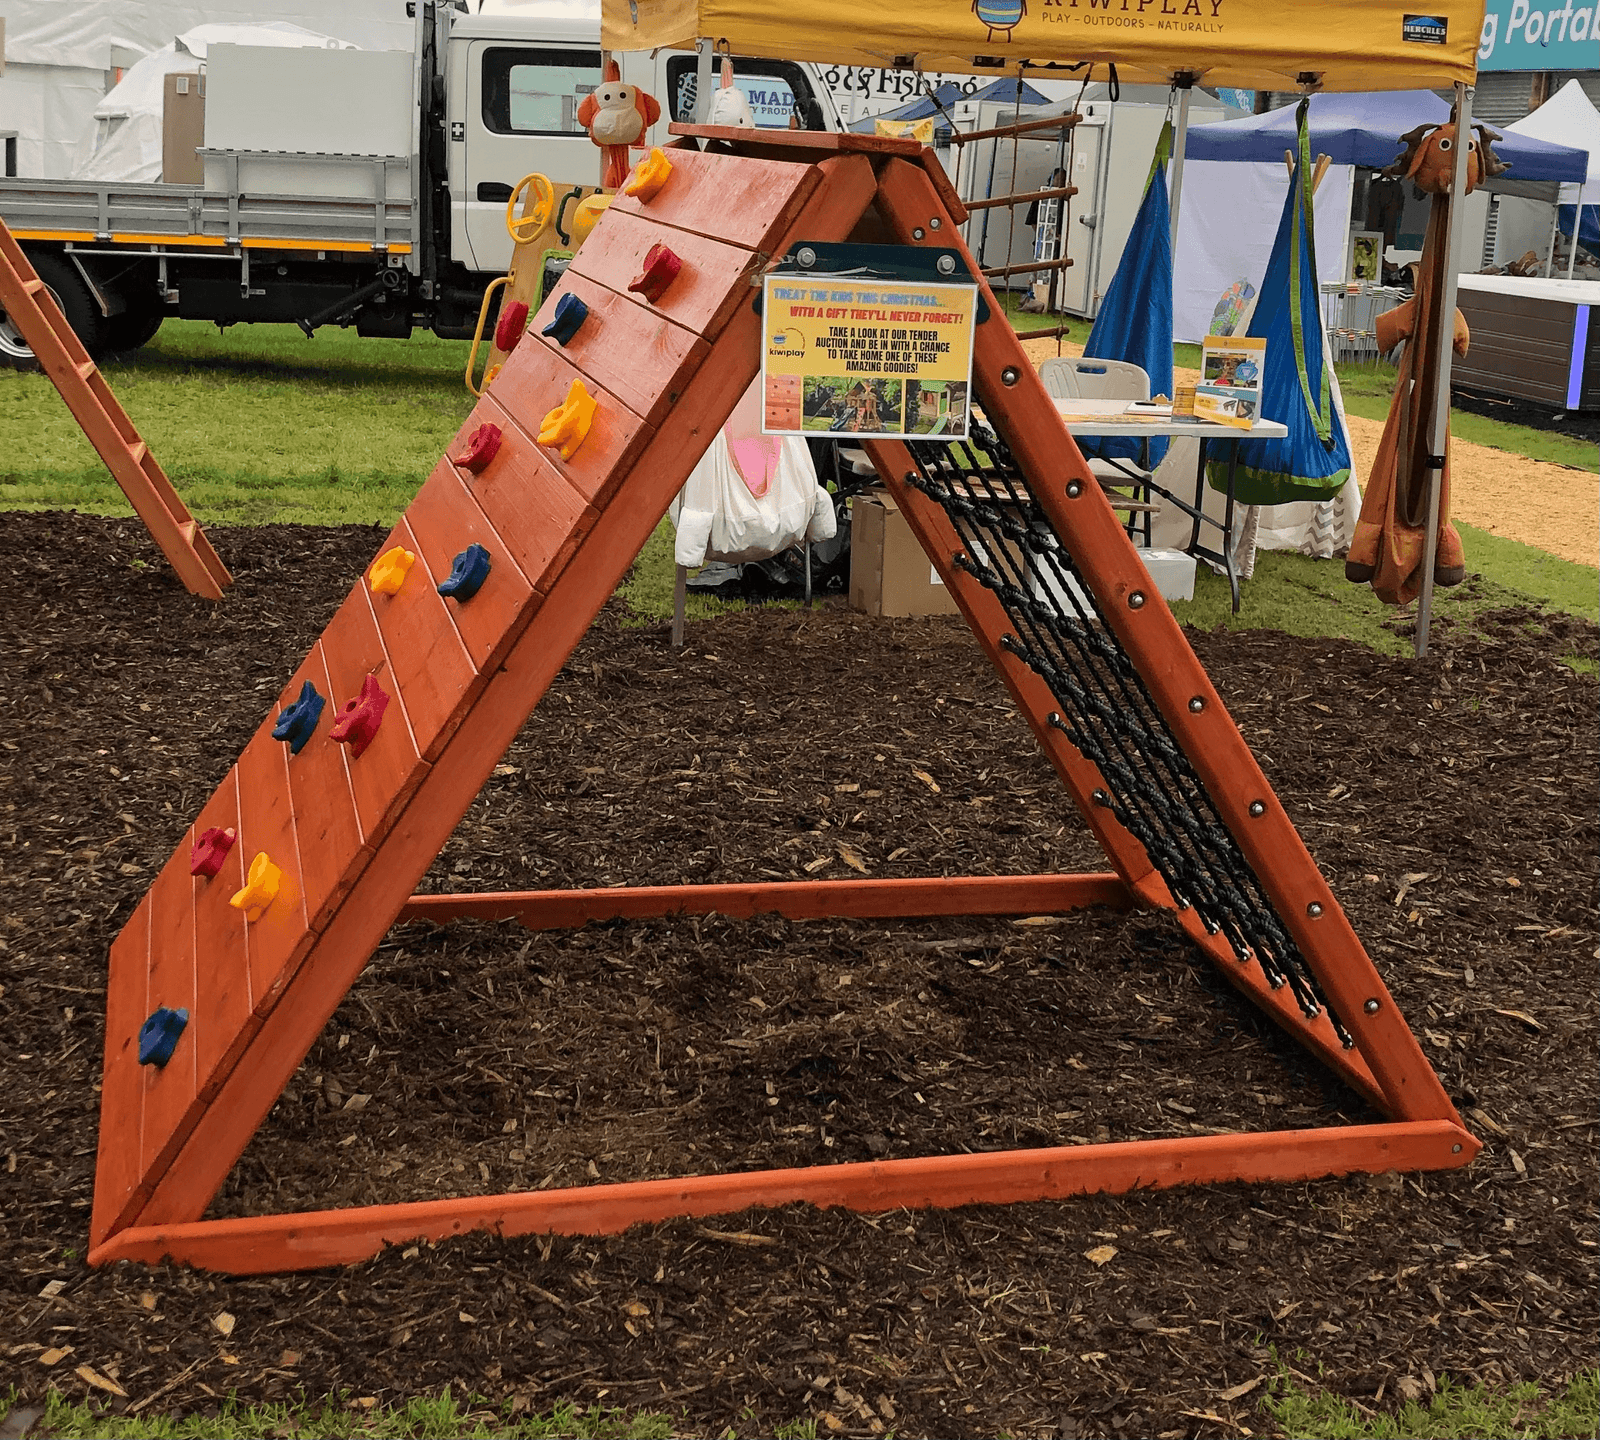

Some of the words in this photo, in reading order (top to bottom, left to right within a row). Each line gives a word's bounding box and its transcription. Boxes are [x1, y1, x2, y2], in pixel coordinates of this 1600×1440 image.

[1042, 12, 1071, 23] PLAY
[1083, 14, 1145, 29] OUTDOORS
[1157, 20, 1224, 33] NATURALLY
[1403, 25, 1446, 35] HERCULES
[790, 306, 815, 317] WITH
[816, 307, 823, 318] A
[826, 308, 848, 318] GIFT
[850, 309, 887, 321] THEY'LL
[889, 311, 921, 322] NEVER
[922, 312, 964, 324] FORGET!
[829, 326, 848, 337] TAKE
[850, 327, 856, 338] A
[858, 327, 878, 339] LOOK
[880, 329, 889, 339] AT
[891, 329, 907, 340] OUR
[909, 330, 938, 341] TENDER
[815, 337, 848, 348] AUCTION
[850, 338, 866, 349] AND
[868, 339, 878, 349] BE
[880, 340, 888, 350] IN
[890, 340, 910, 351] WITH
[912, 341, 917, 351] A
[920, 341, 950, 353] CHANCE
[769, 348, 805, 358] kiwiplay
[827, 349, 837, 359] TO
[839, 349, 858, 360] TAKE
[860, 350, 883, 361] HOME
[885, 351, 900, 361] ONE
[902, 352, 912, 362] OF
[914, 352, 937, 363] THESE
[845, 361, 881, 372] AMAZING
[883, 362, 918, 374] GOODIES!
